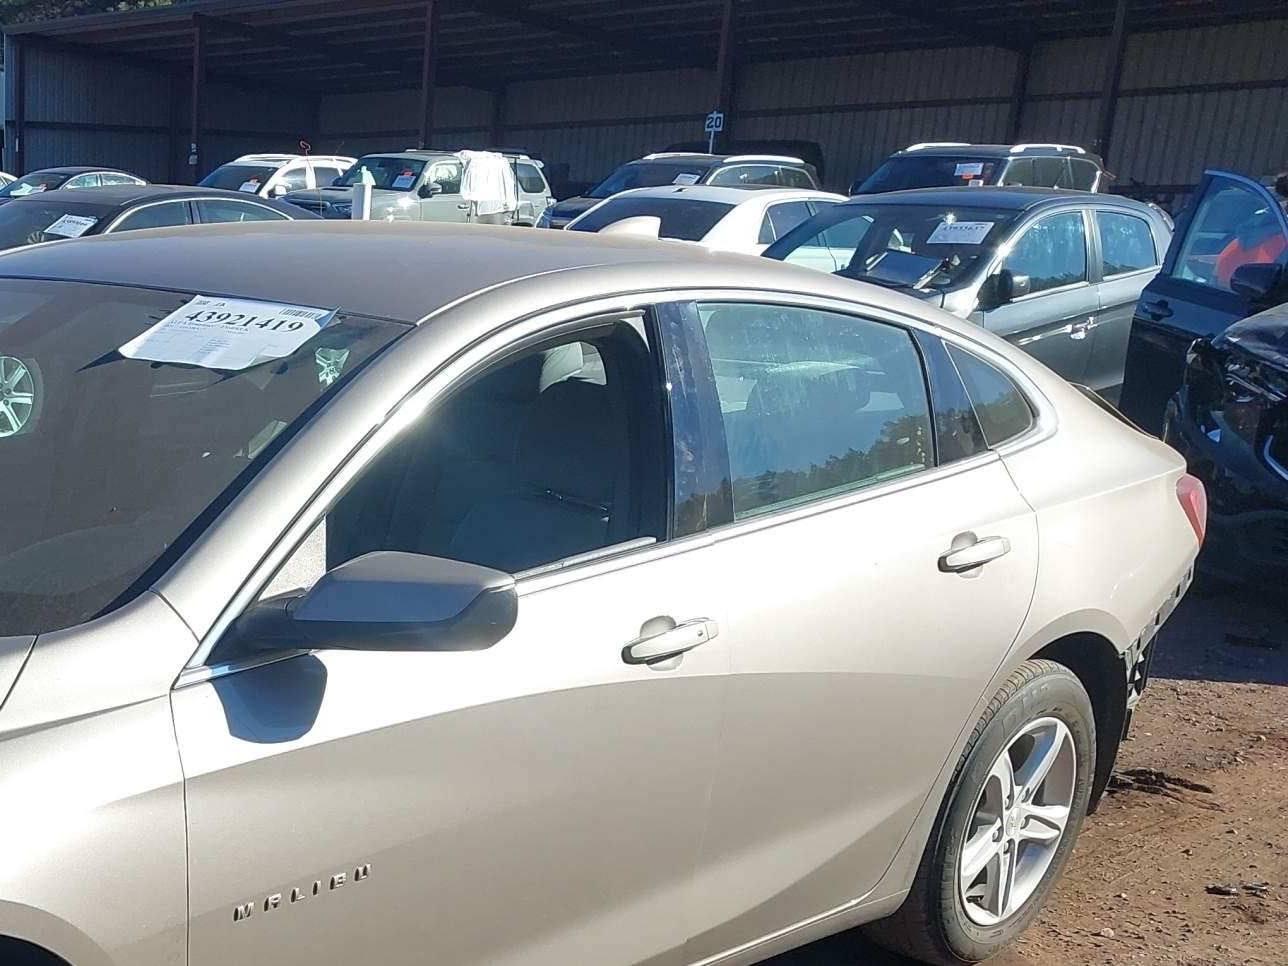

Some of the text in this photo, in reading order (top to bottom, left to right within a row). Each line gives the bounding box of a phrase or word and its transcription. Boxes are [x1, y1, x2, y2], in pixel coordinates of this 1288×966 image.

[706, 116, 722, 129] 20
[185, 310, 305, 333] 43921419
[232, 863, 372, 922] MALIBU
